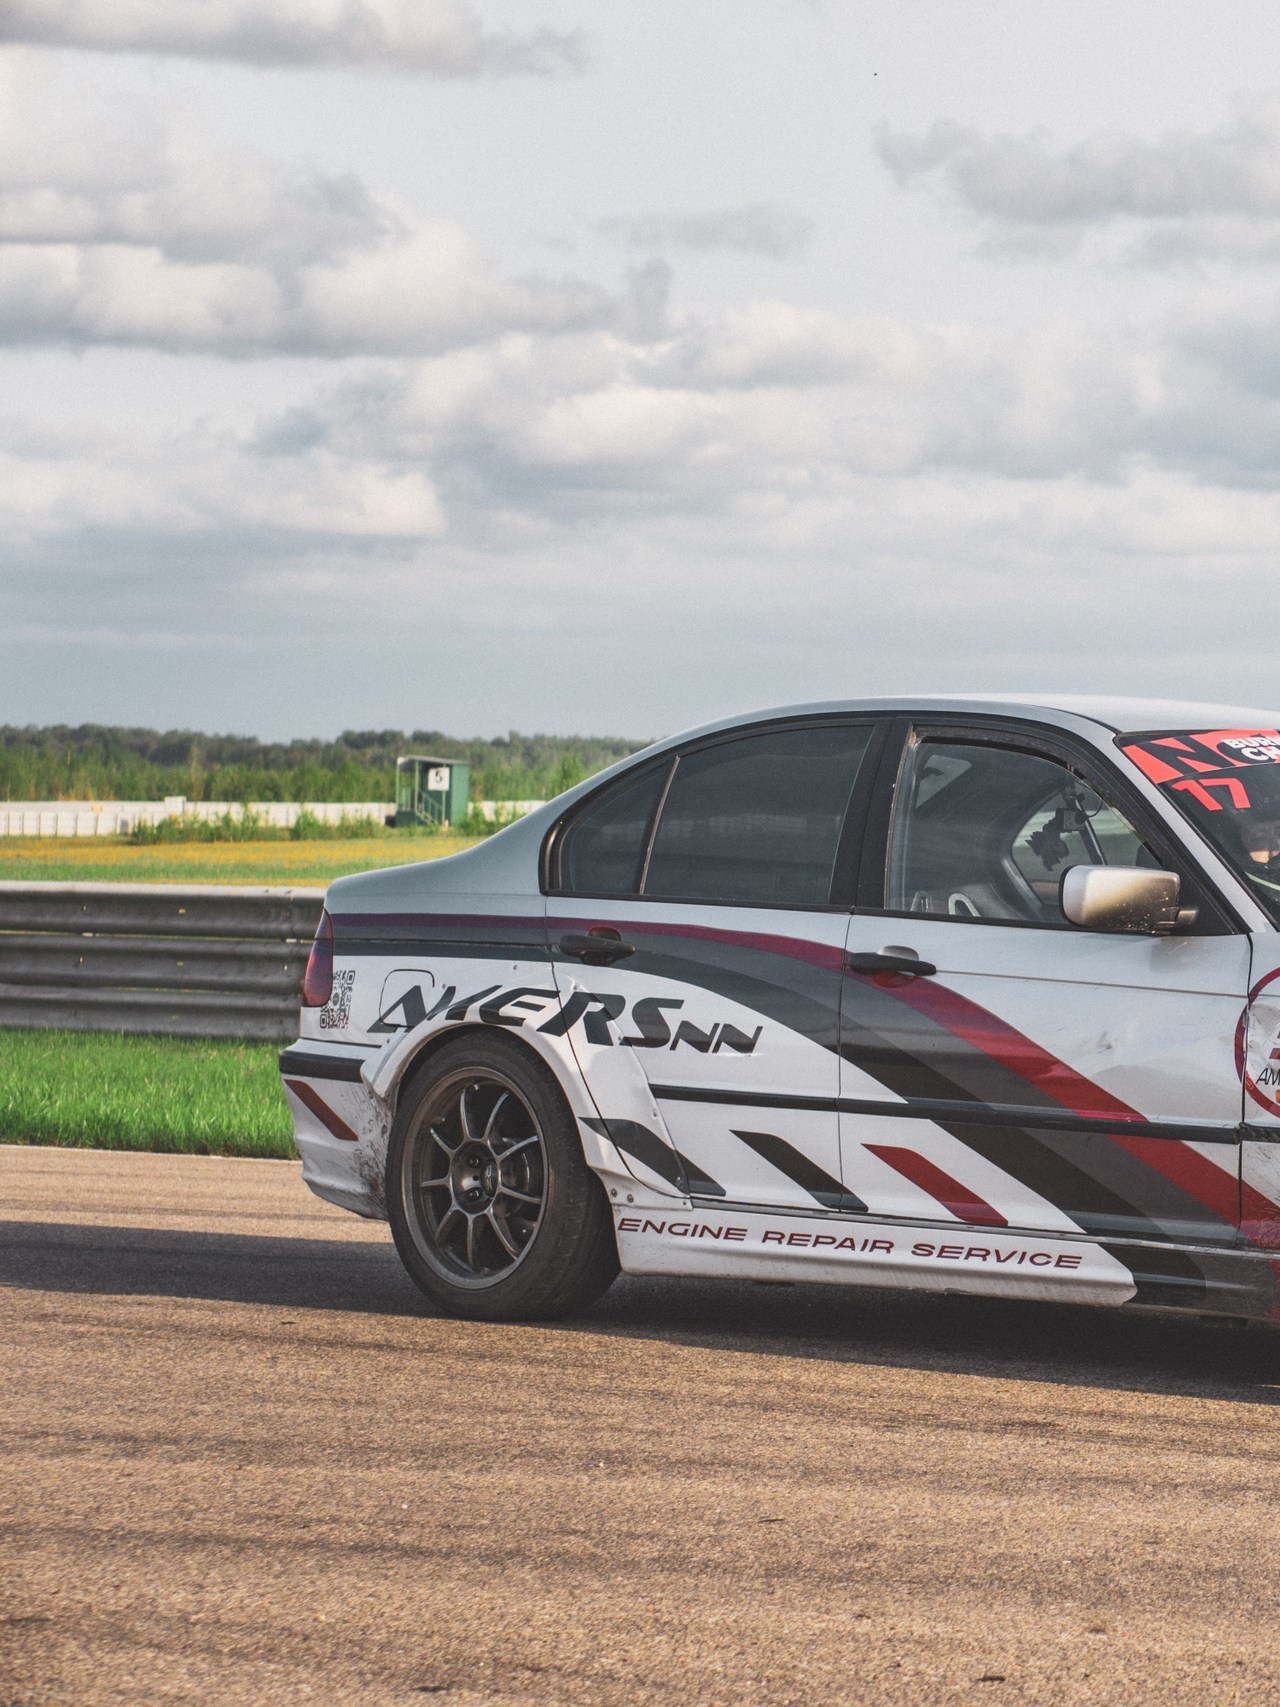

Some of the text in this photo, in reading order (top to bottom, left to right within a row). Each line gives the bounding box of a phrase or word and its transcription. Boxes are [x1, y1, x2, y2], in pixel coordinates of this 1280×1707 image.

[1171, 778, 1251, 811] 17
[617, 1217, 1083, 1270] ENGINE REPAIR SERVICE
